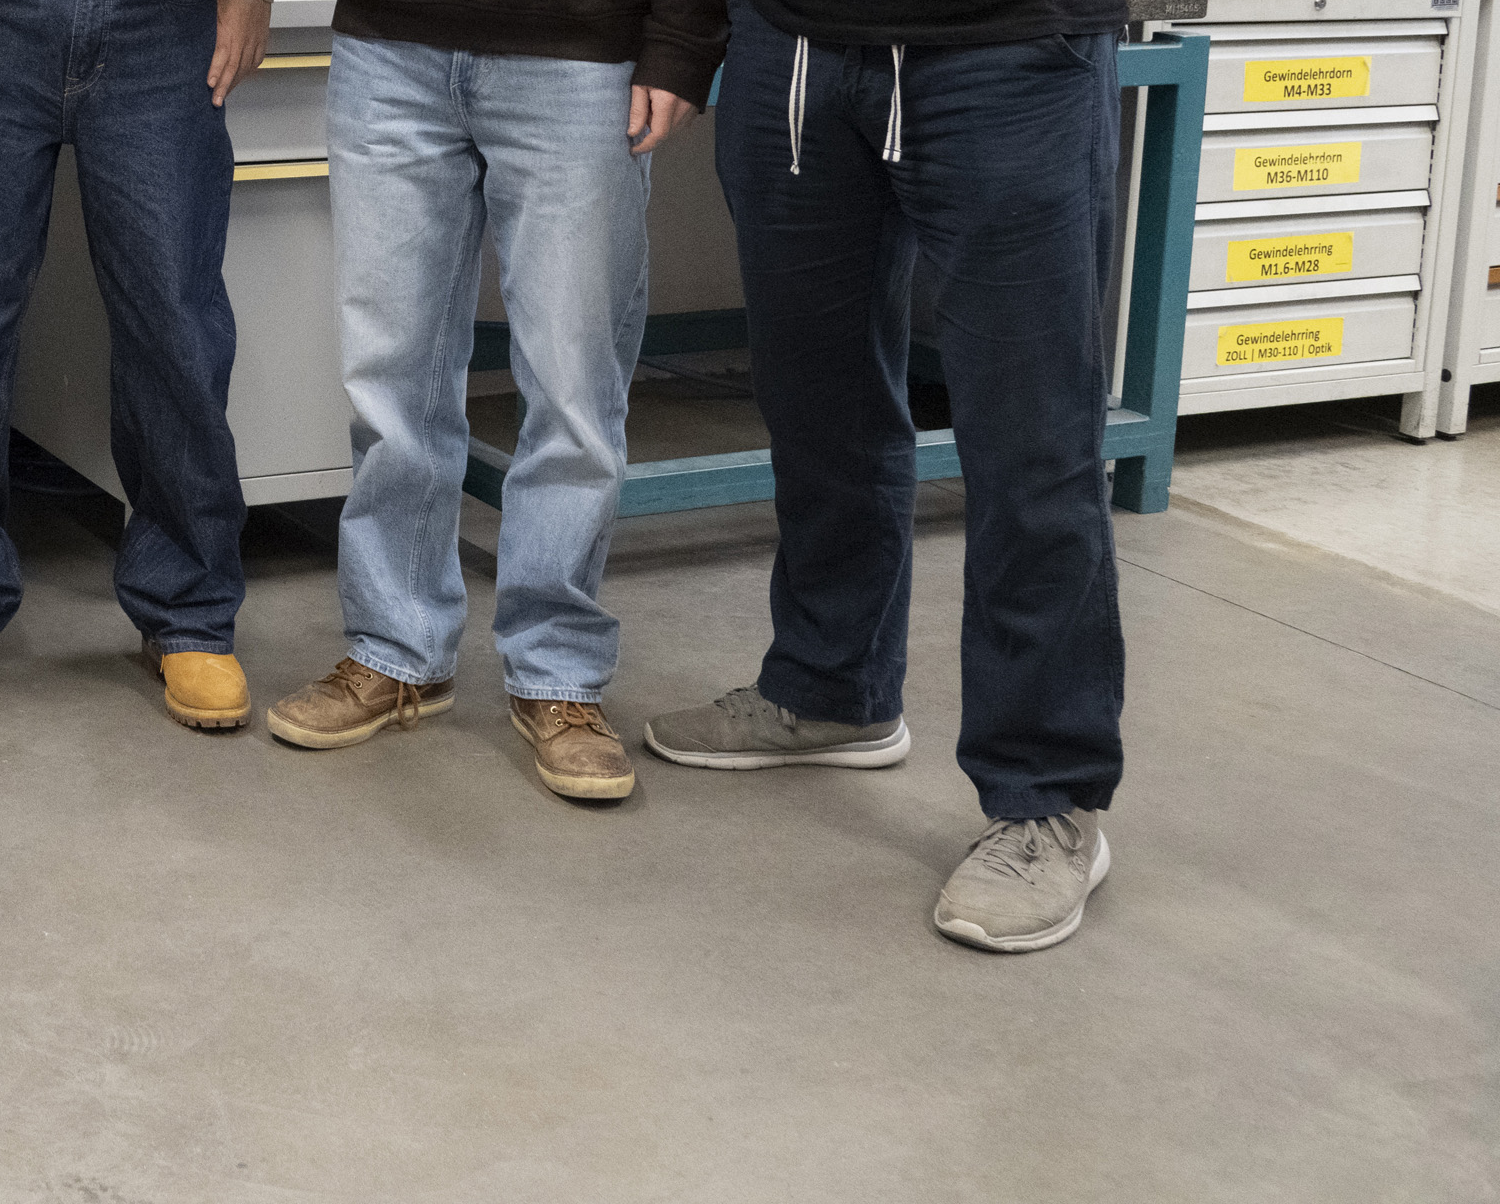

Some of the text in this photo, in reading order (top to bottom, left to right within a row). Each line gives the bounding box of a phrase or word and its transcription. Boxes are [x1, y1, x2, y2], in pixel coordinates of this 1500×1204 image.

[1263, 67, 1353, 83] Gewindelehrdorn
[1283, 82, 1332, 98] M4-M33
[1254, 151, 1343, 168] Gewindelehrdorn
[1266, 168, 1329, 185] M36-M110
[1249, 242, 1333, 261] Gewindelehrring
[1236, 328, 1321, 347] Gewindelehrring
[1225, 349, 1248, 362] ZOLL
[1257, 346, 1299, 359] M30-110
[1308, 343, 1332, 356] Optik
